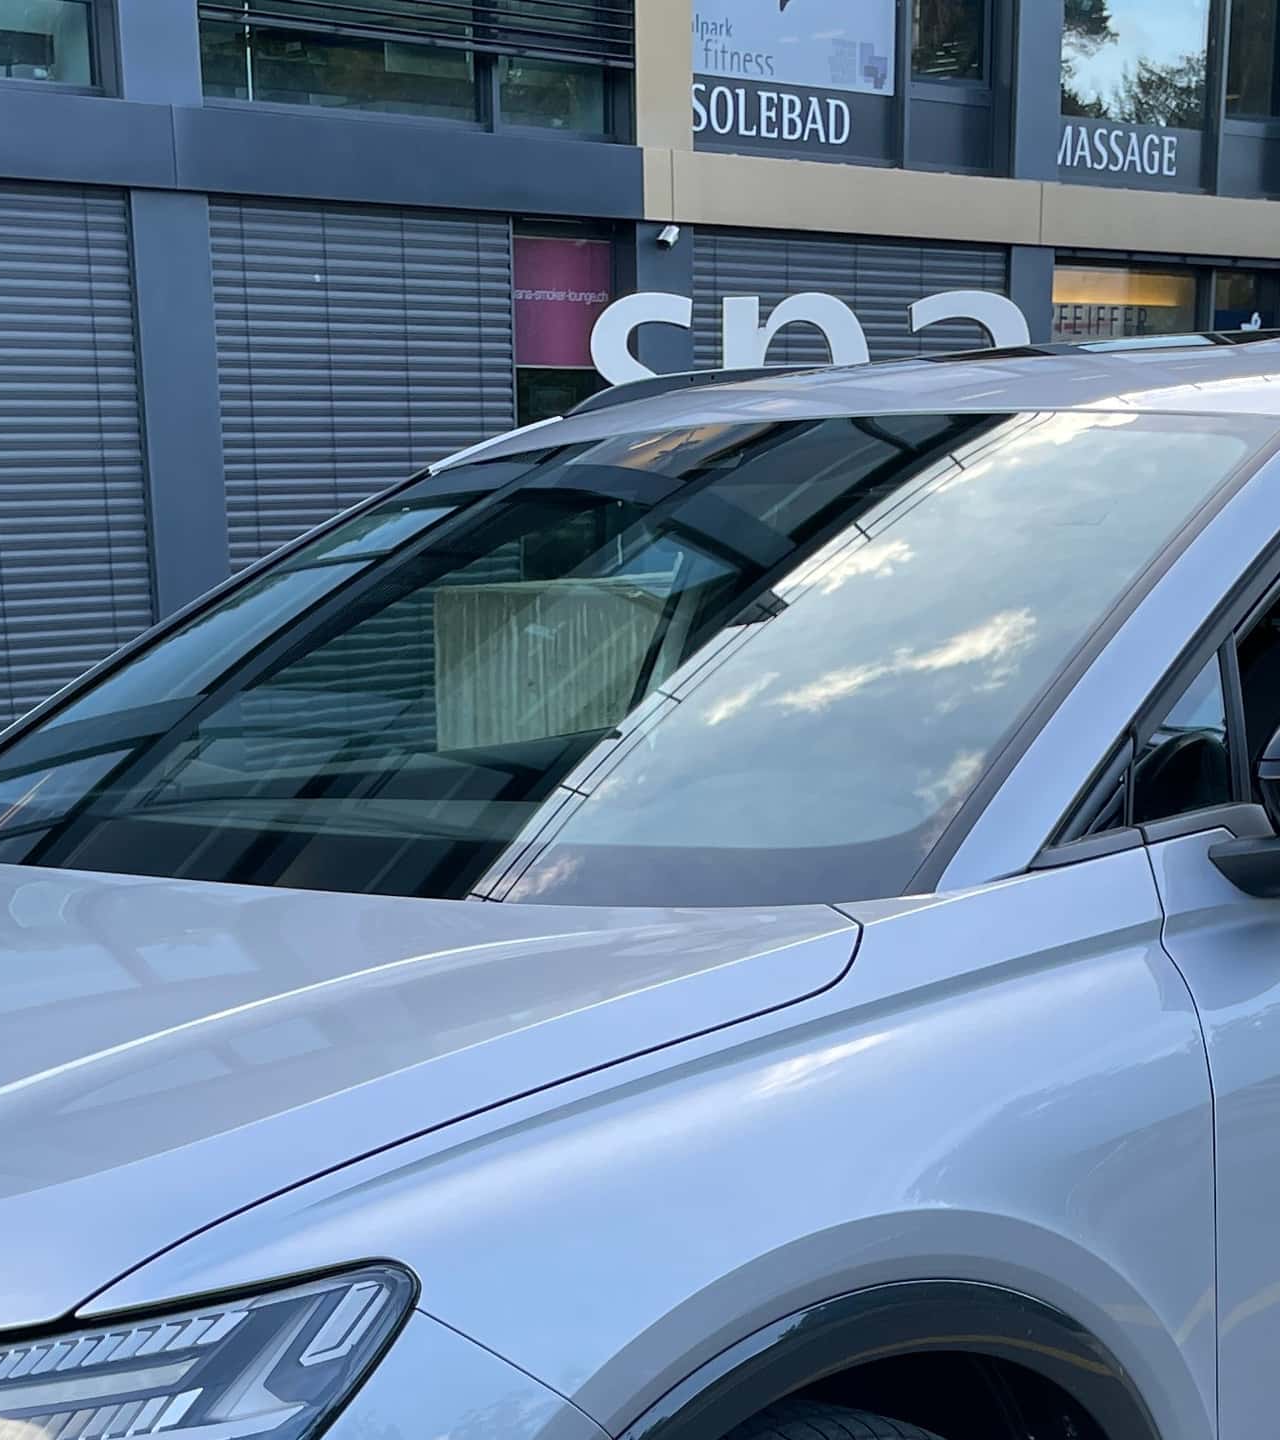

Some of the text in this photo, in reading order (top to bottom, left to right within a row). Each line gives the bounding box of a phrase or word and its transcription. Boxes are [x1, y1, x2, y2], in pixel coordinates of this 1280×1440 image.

[692, 14, 733, 41] lpark
[704, 39, 775, 77] fitness
[691, 83, 851, 145] SOLEBAD
[1051, 304, 1148, 337] FEIFFER
